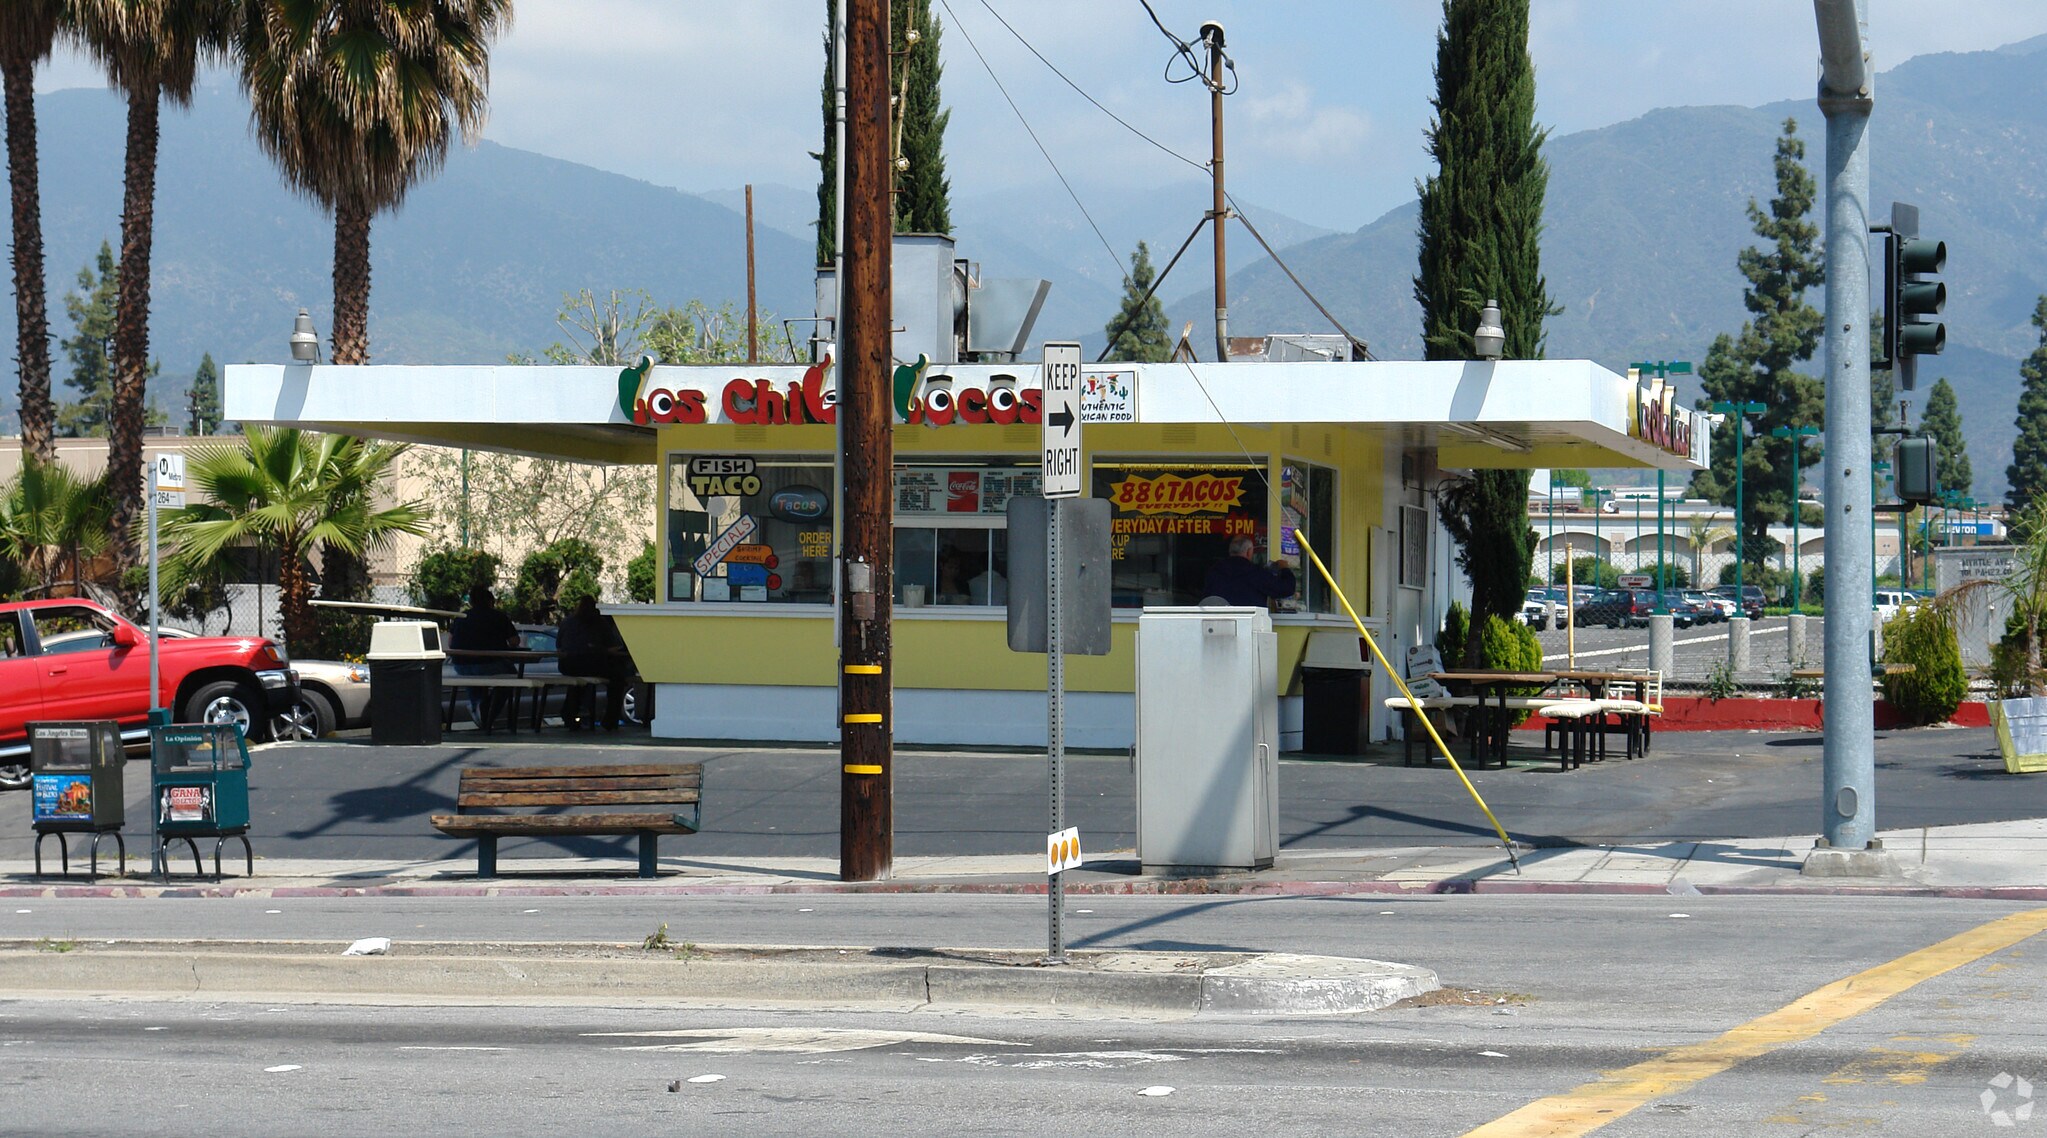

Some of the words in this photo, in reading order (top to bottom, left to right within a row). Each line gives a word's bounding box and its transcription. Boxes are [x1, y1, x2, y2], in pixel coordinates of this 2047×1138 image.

[1047, 363, 1077, 391] KEEP
[1082, 403, 1126, 411] UTHENTIC
[1082, 413, 1108, 421] XICAN
[1110, 413, 1132, 421] FOOD
[699, 460, 747, 473] FISH
[1046, 448, 1078, 476] RIGHT
[691, 475, 761, 496] TACO
[1167, 479, 1240, 502] TACOS
[158, 492, 170, 504] 264
[1136, 502, 1210, 510] EVERYDAY
[1111, 518, 1164, 534] VERYDAY
[1167, 519, 1212, 534] AFTER
[1225, 519, 1233, 534] 5
[1235, 519, 1254, 534] PM
[799, 532, 832, 544] ORDER
[696, 518, 752, 573] SPECIALS
[802, 545, 829, 558] HERE
[47, 729, 69, 738] Angeles
[171, 788, 200, 798] GANA
